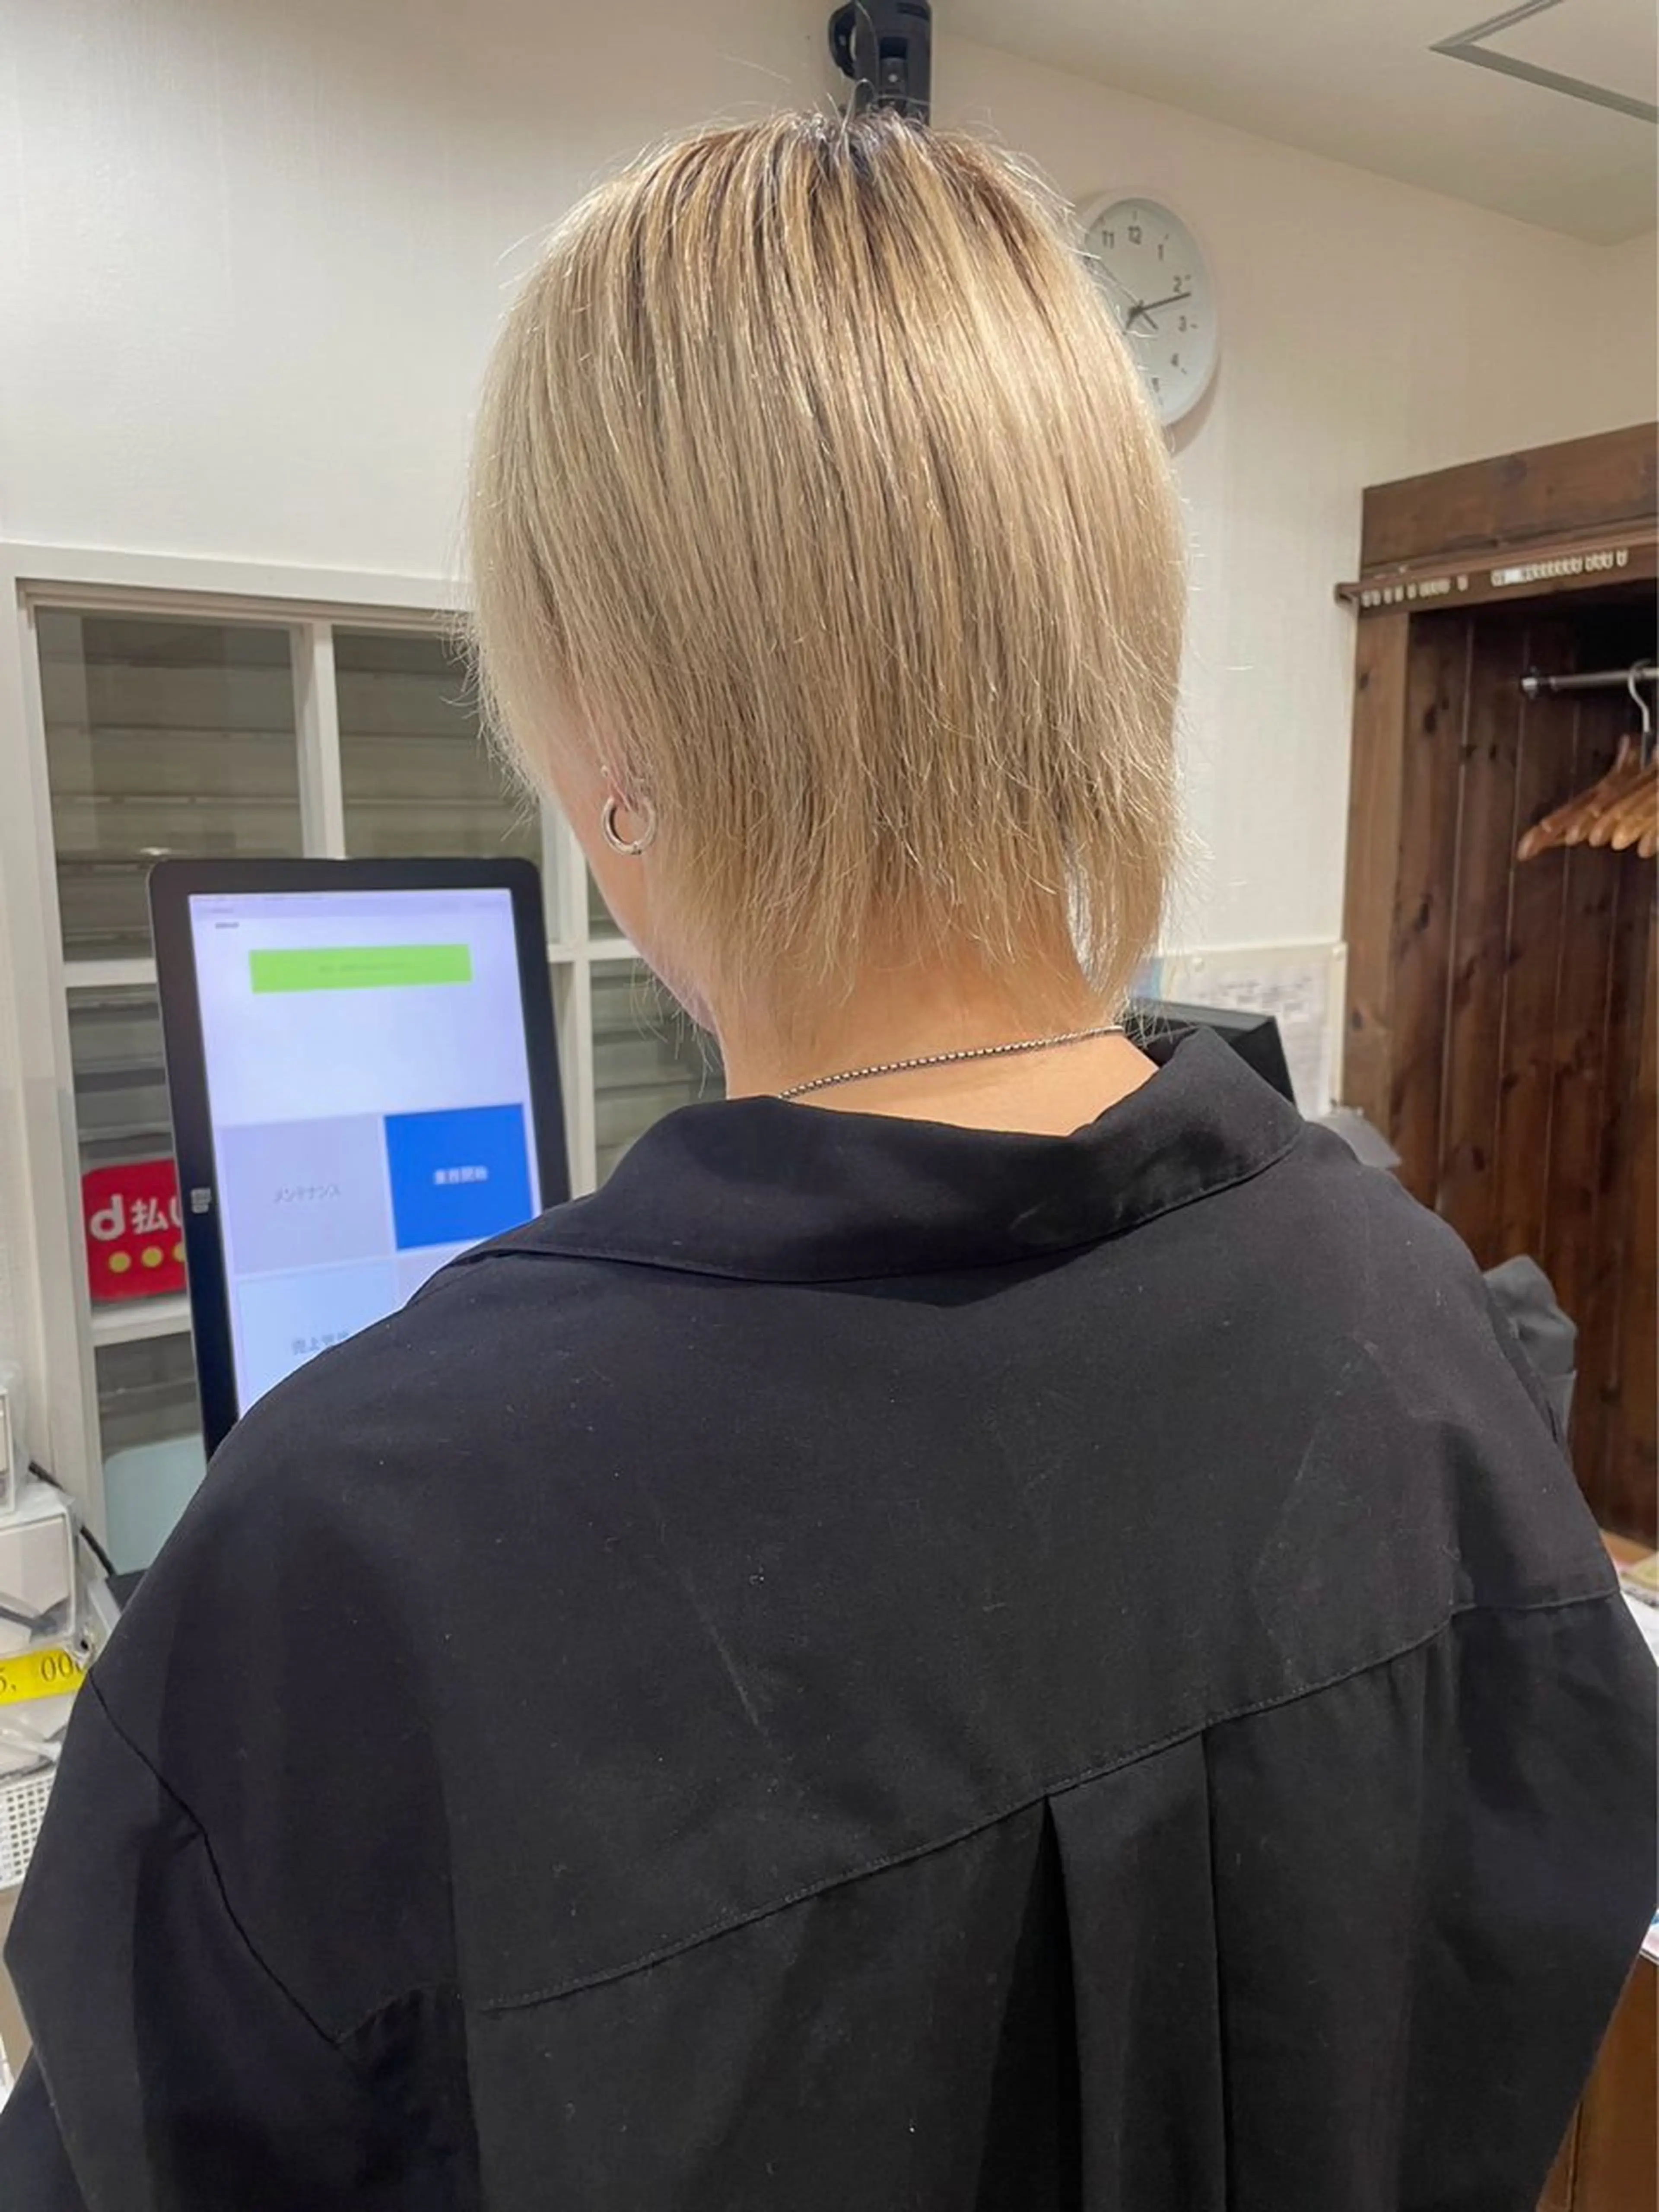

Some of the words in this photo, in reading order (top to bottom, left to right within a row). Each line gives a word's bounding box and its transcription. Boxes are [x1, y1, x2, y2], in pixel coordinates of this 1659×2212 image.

[1102, 230, 1115, 249] 11
[1127, 225, 1142, 245] 12
[1157, 243, 1164, 261] 1
[1173, 274, 1182, 294] 2
[1178, 315, 1187, 333] 3
[273, 1184, 340, 1204] メンテナンス
